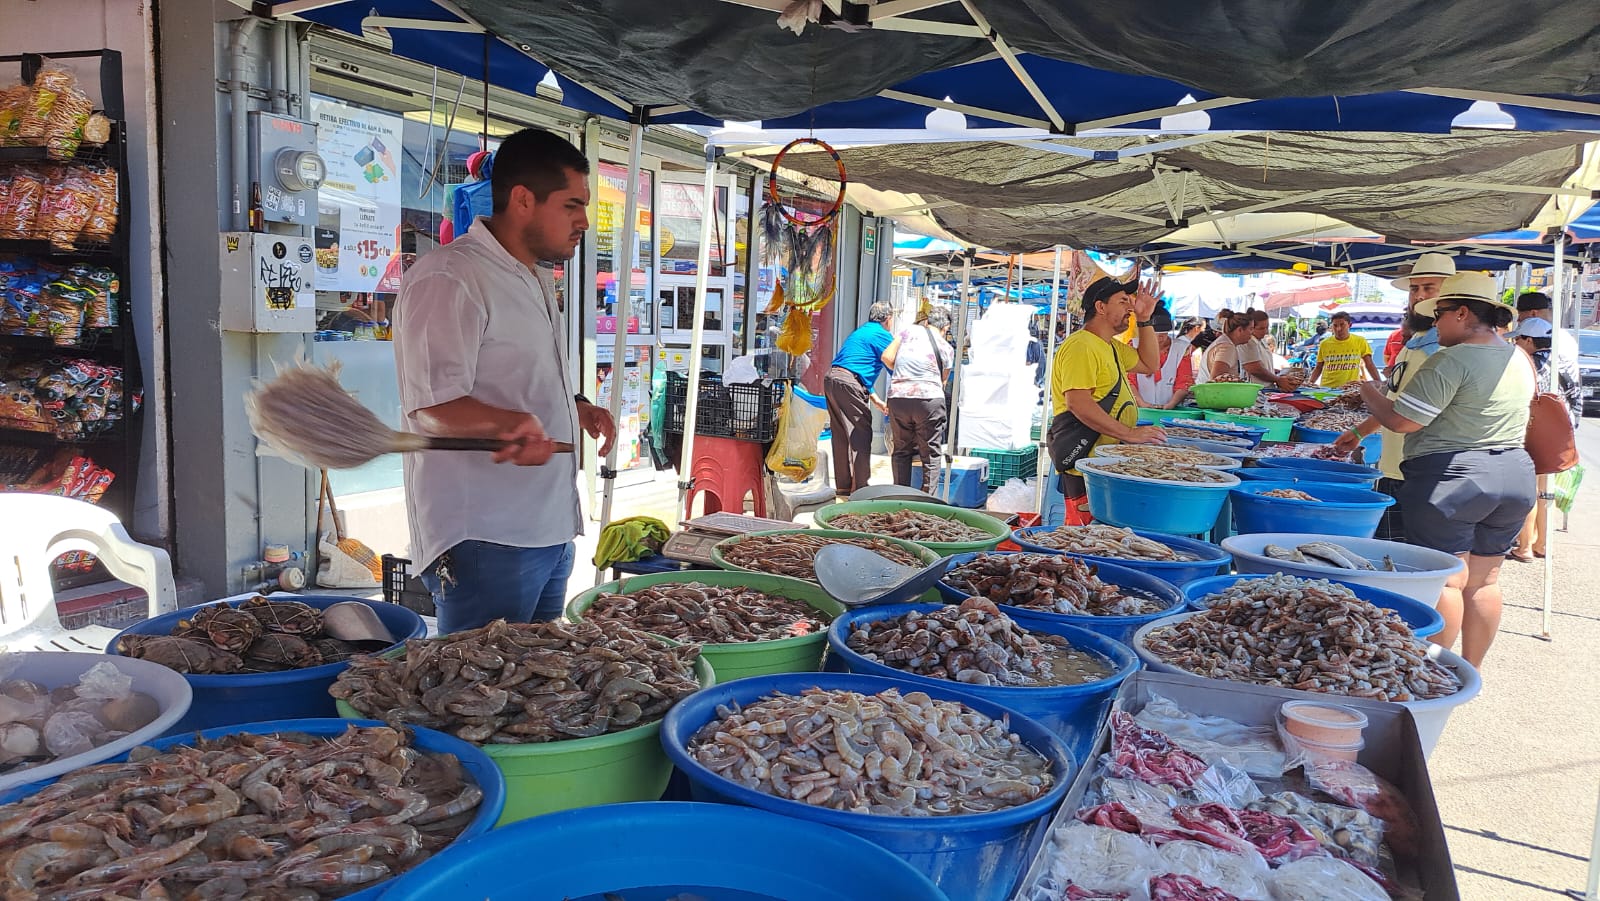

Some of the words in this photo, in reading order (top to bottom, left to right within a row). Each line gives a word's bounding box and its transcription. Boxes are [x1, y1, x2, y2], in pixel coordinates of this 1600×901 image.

[319, 112, 337, 123] RETIRA
[338, 117, 361, 129] EFECTIVO
[357, 239, 379, 261] $15
